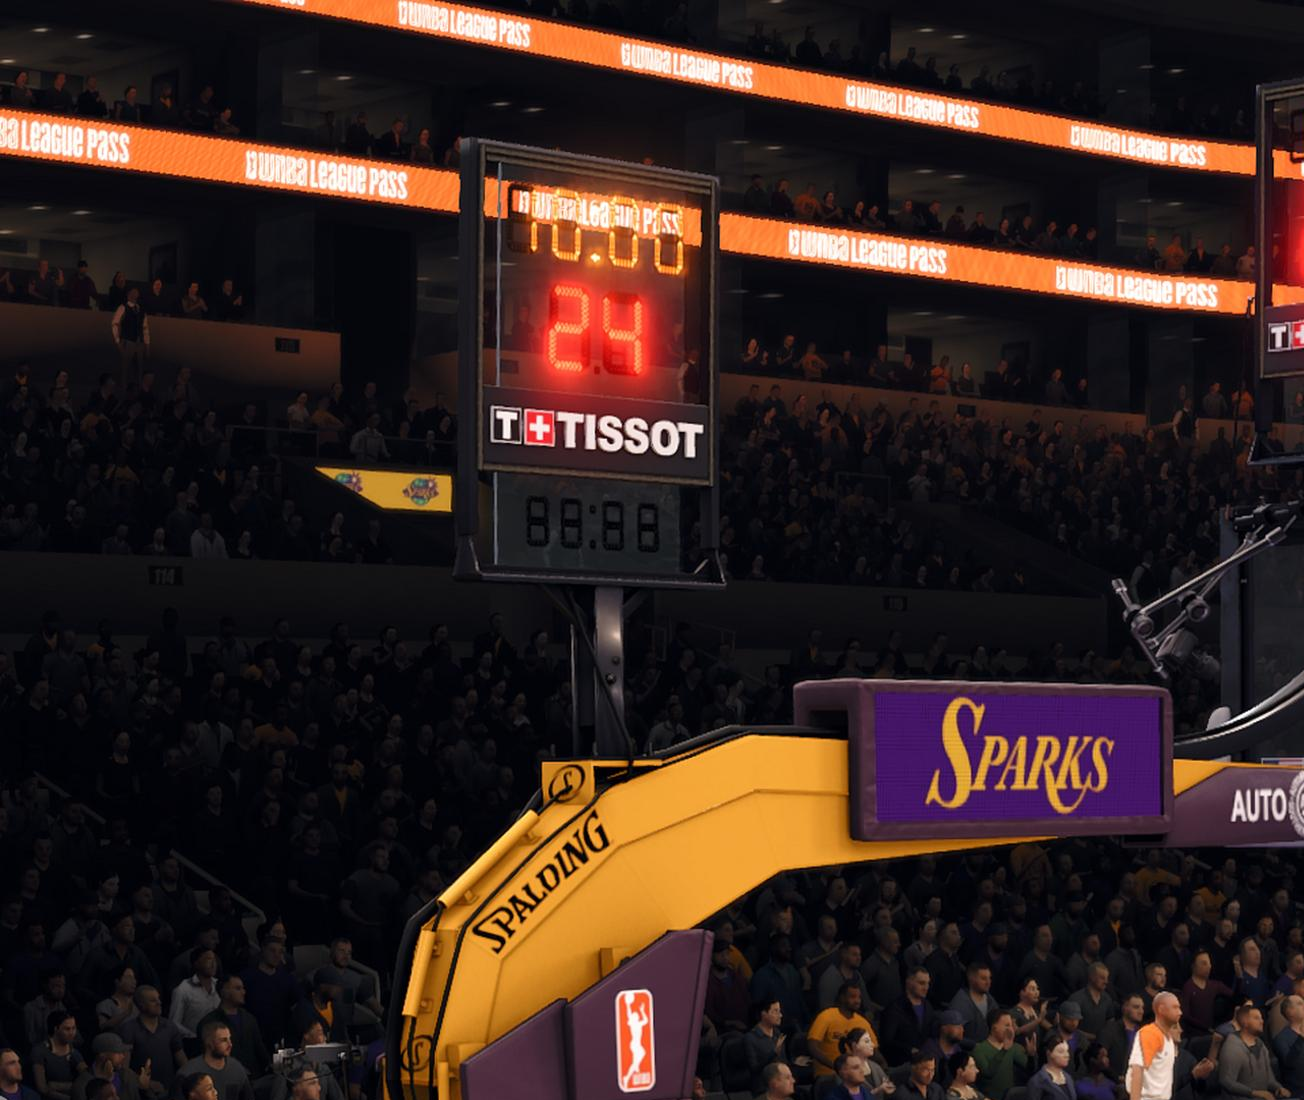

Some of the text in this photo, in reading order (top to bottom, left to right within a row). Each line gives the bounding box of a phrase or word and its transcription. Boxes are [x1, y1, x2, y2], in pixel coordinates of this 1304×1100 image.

[86, 128, 130, 163] PASS
[1231, 789, 1287, 822] AUTO
[472, 811, 610, 954] SPALDING
